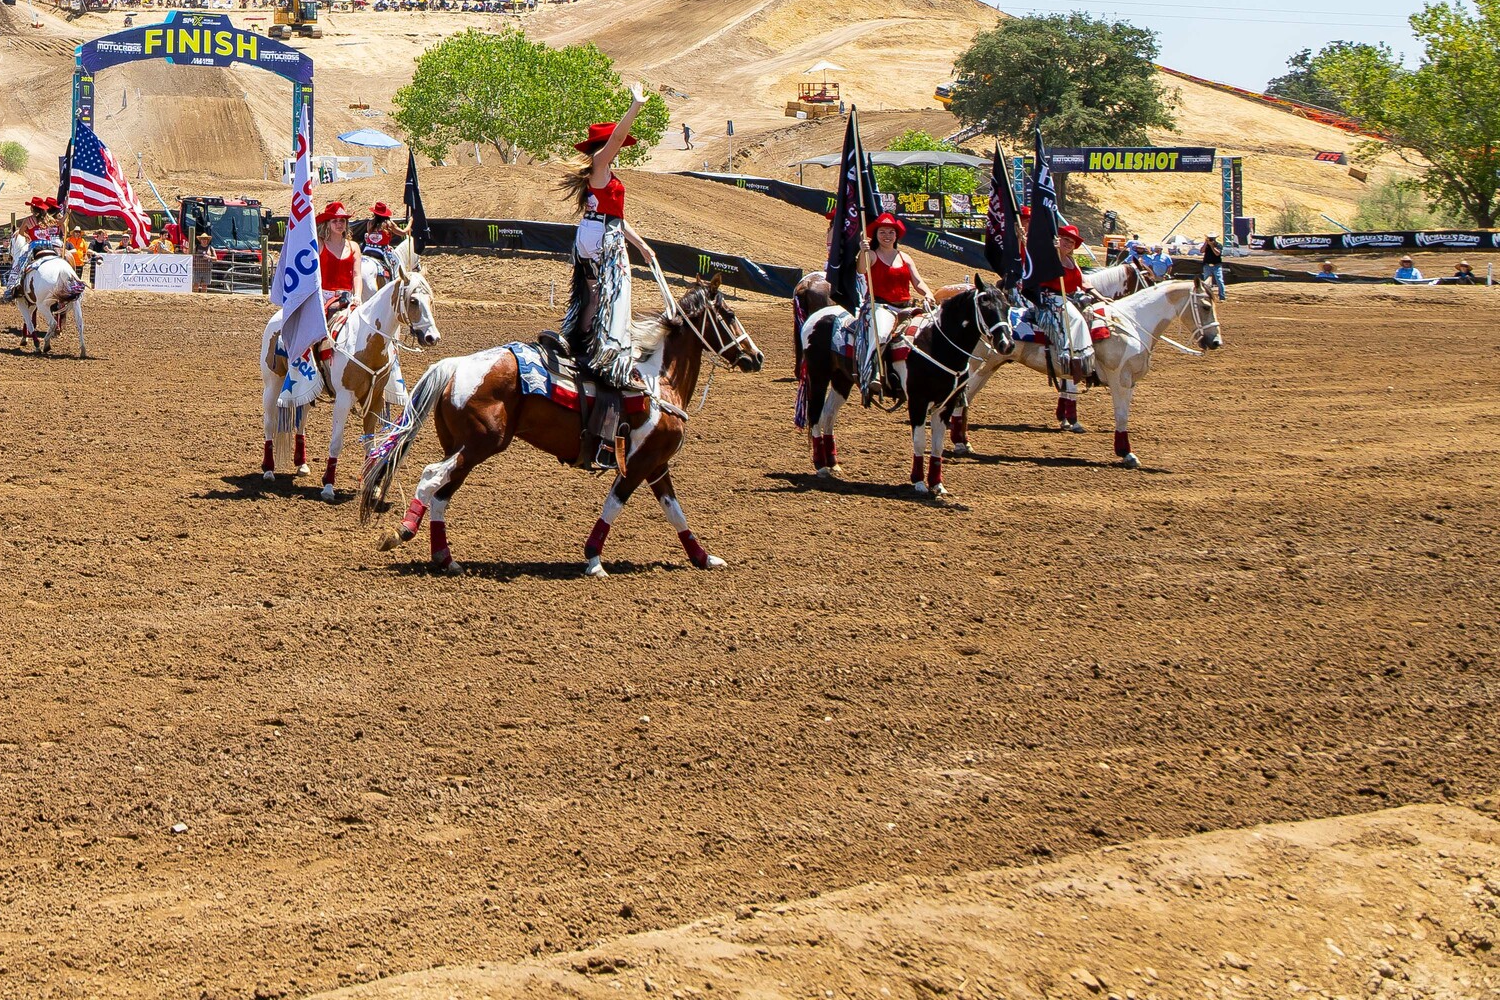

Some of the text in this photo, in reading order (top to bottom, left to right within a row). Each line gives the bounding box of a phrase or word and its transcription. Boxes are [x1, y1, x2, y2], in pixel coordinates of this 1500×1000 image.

[182, 15, 204, 27] SMX
[97, 43, 142, 52] MOTOCROSS
[144, 28, 258, 61] FINISH
[260, 53, 300, 61] MOTOCROSS
[1088, 152, 1179, 170] HOLESHOT
[1342, 234, 1382, 247] MICHAEL'S
[1382, 234, 1405, 243] RENO
[1415, 233, 1458, 246] MICHAEL'S
[1458, 234, 1481, 244] RENO
[123, 262, 189, 274] PARAGON
[710, 260, 739, 273] MONSTER
[122, 275, 173, 284] MECHANICAL
